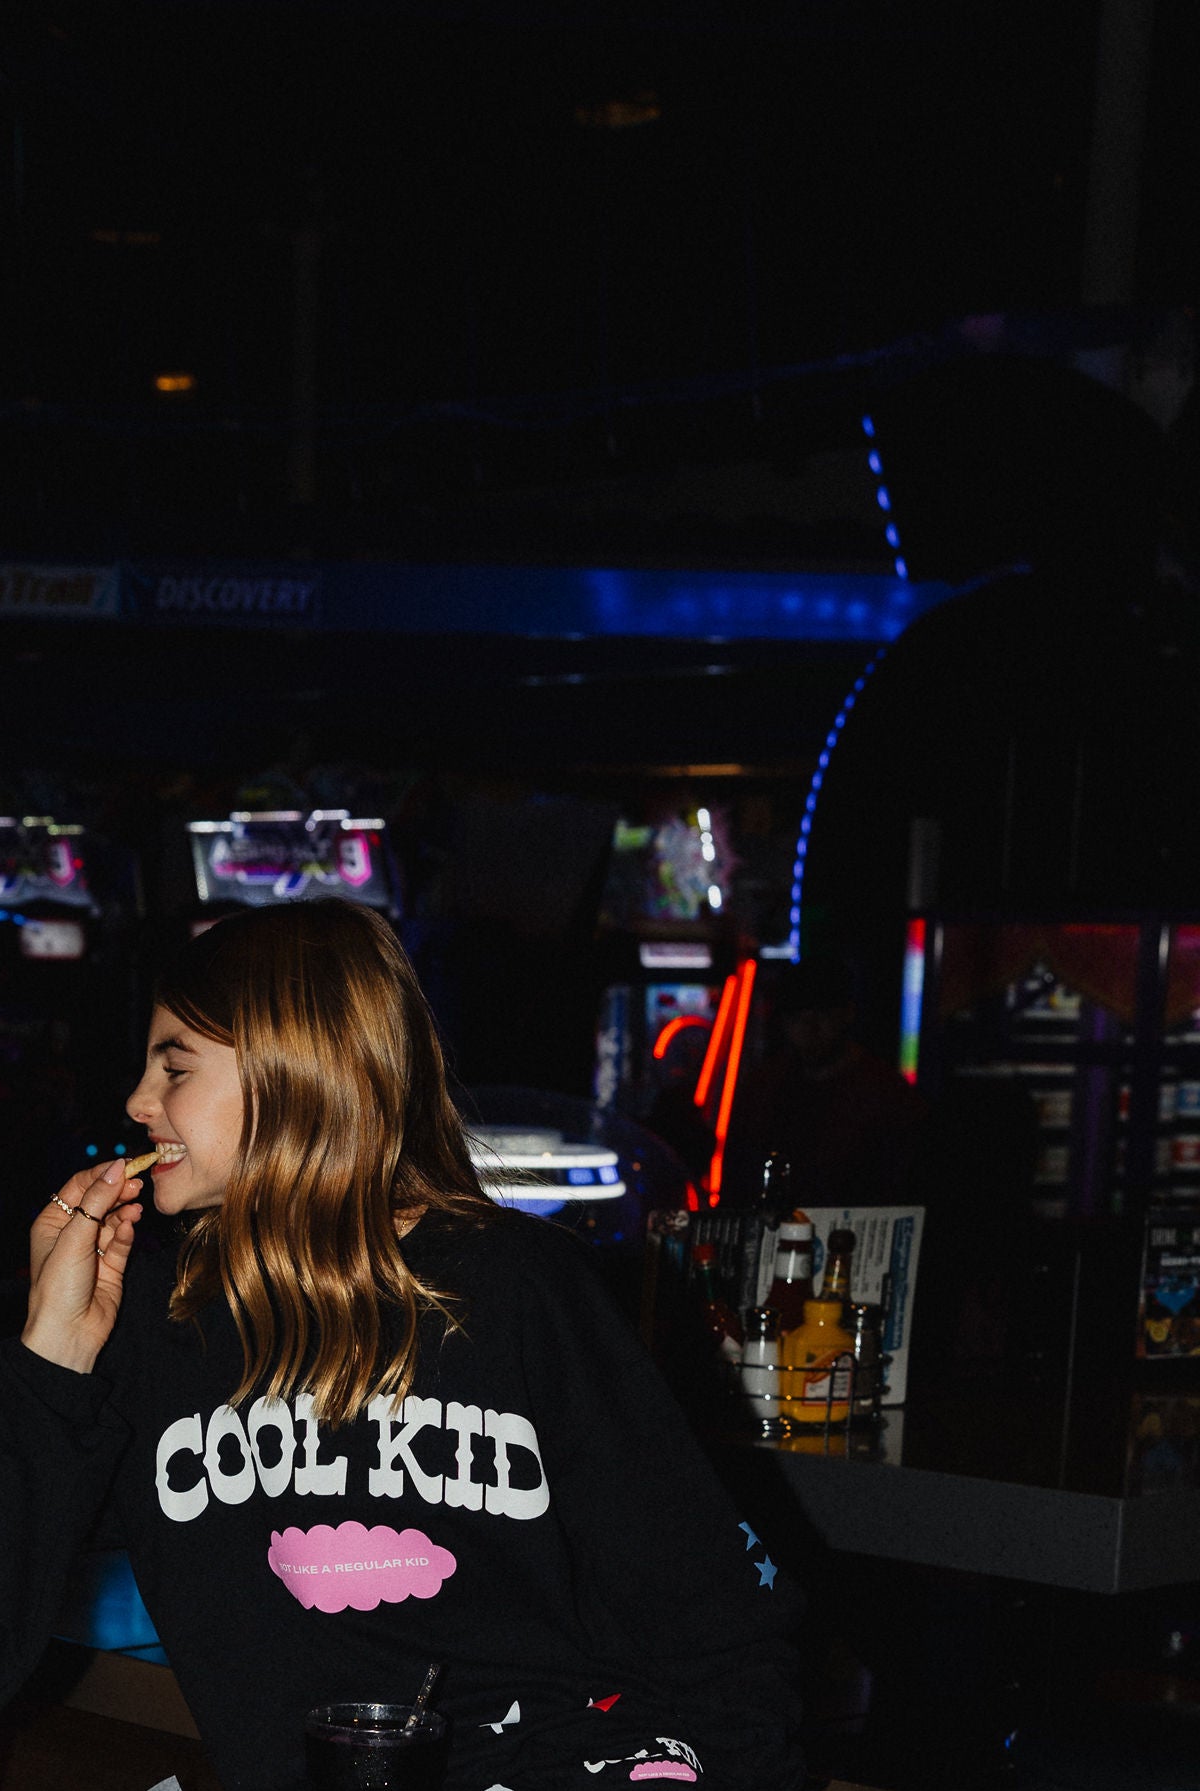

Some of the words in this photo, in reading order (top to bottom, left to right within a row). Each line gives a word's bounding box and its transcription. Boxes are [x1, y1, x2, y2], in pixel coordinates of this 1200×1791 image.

[156, 576, 313, 612] DISCOVERY
[155, 1392, 348, 1522] COOL
[368, 1393, 550, 1520] KID
[293, 1565, 318, 1575] LIKE
[321, 1564, 332, 1574] A
[335, 1558, 402, 1573] REGULAR
[405, 1556, 429, 1567] KID
